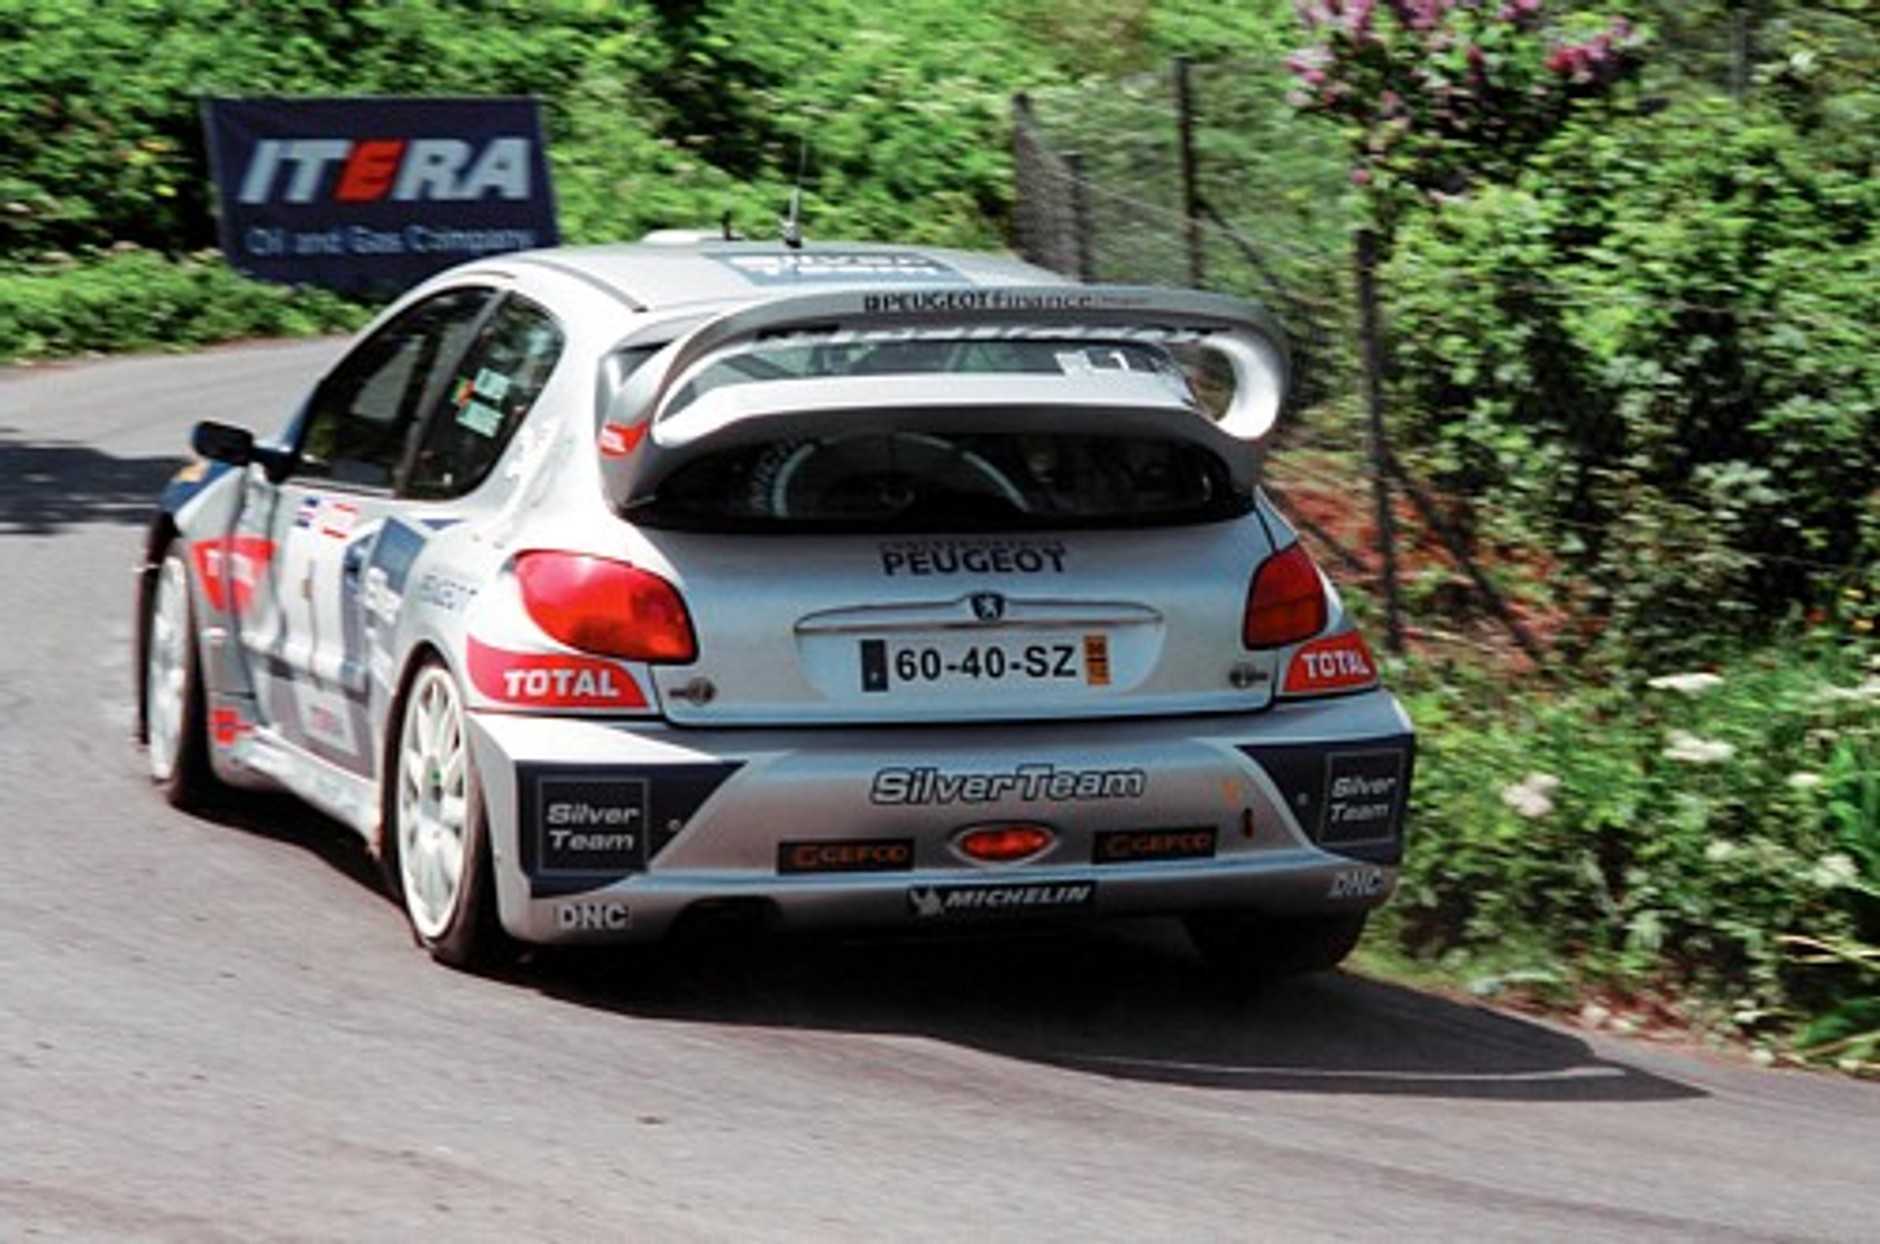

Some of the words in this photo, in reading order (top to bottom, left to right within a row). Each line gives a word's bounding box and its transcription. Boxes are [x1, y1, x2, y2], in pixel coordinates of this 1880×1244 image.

[239, 138, 531, 204] ITERA
[247, 228, 285, 254] Oil
[294, 228, 346, 254] and
[350, 225, 402, 254] Gas
[405, 224, 536, 256] Company
[883, 290, 990, 310] PEUGEOT
[883, 547, 1066, 576] PEUGEOT
[895, 645, 1078, 682] 60-40-SZ
[1302, 652, 1371, 679] TOTAL
[503, 668, 620, 697] TOTAL
[1331, 777, 1396, 798] Silver
[547, 803, 641, 826] Silver
[1331, 803, 1389, 822] Team
[549, 830, 635, 851] Team
[944, 885, 1092, 908] MICHELIN
[558, 903, 630, 930] DNC
